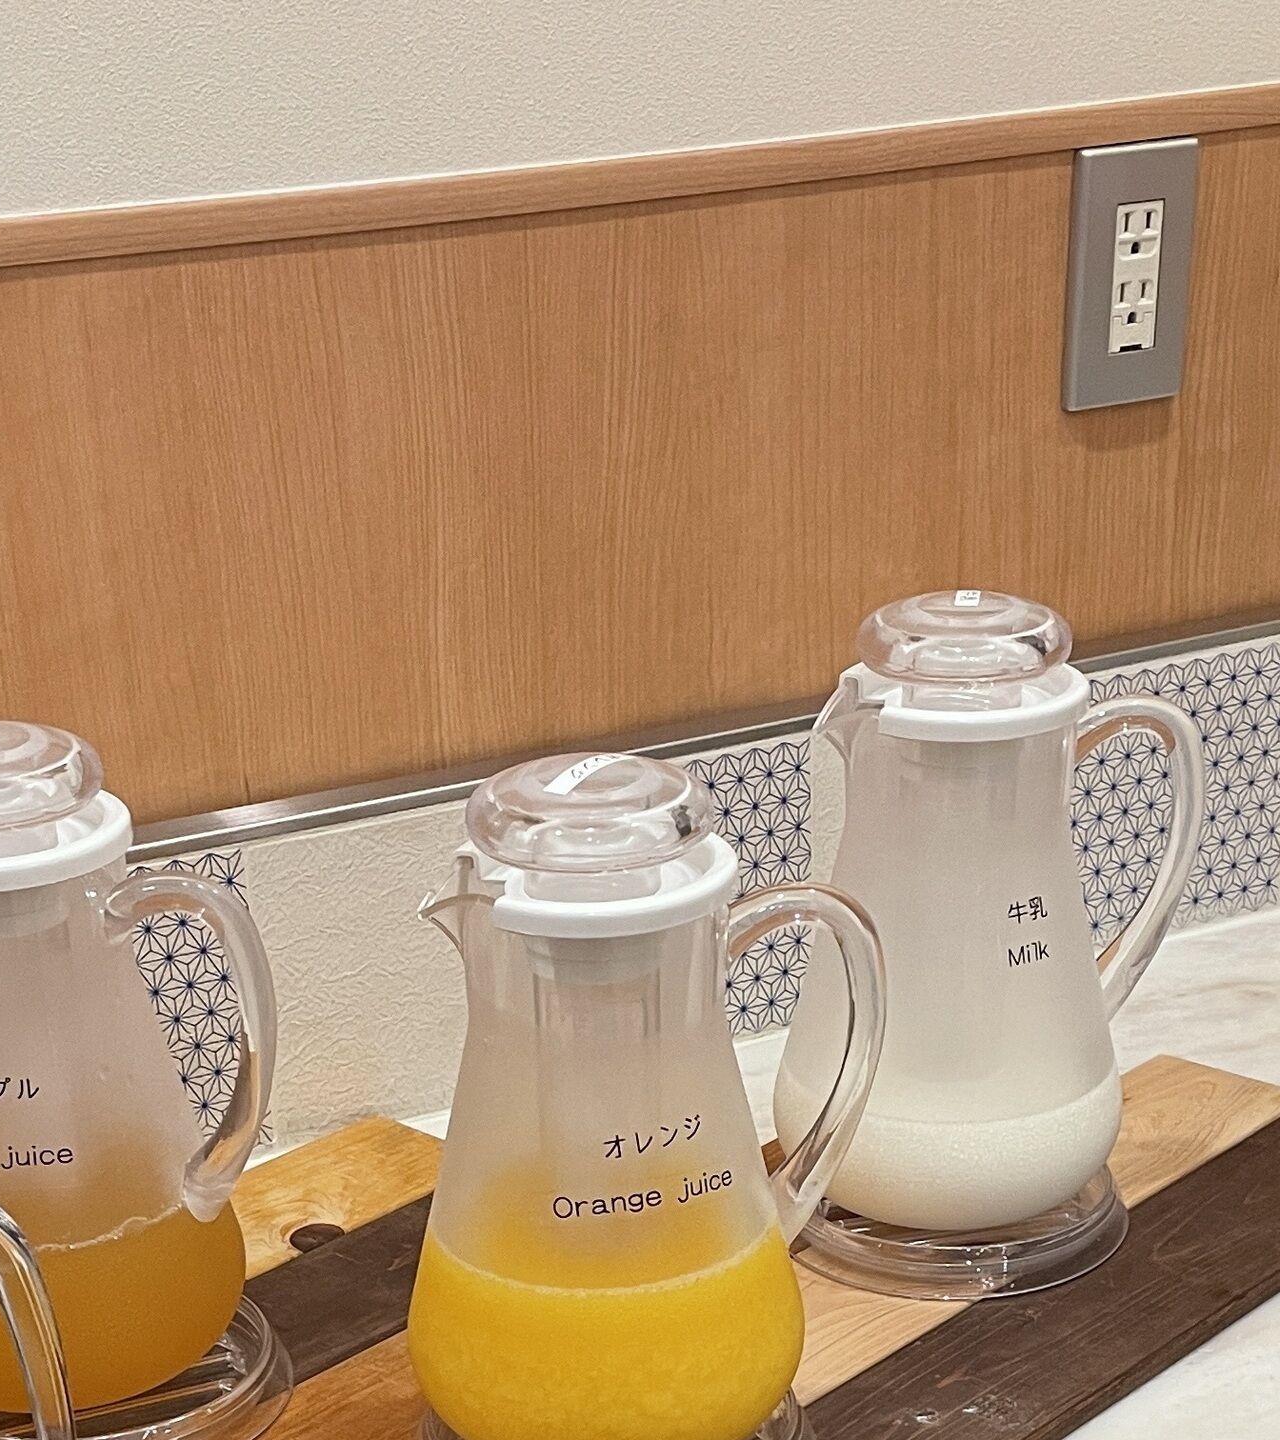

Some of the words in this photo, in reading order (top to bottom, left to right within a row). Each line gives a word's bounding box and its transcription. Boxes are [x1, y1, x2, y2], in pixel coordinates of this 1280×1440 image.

[1008, 896, 1048, 924] 牛乳
[1008, 941, 1050, 967] Milk
[603, 1114, 701, 1158] オレンジ
[1, 1145, 74, 1170] juice
[552, 1190, 662, 1219] Orange
[677, 1169, 733, 1204] juice
